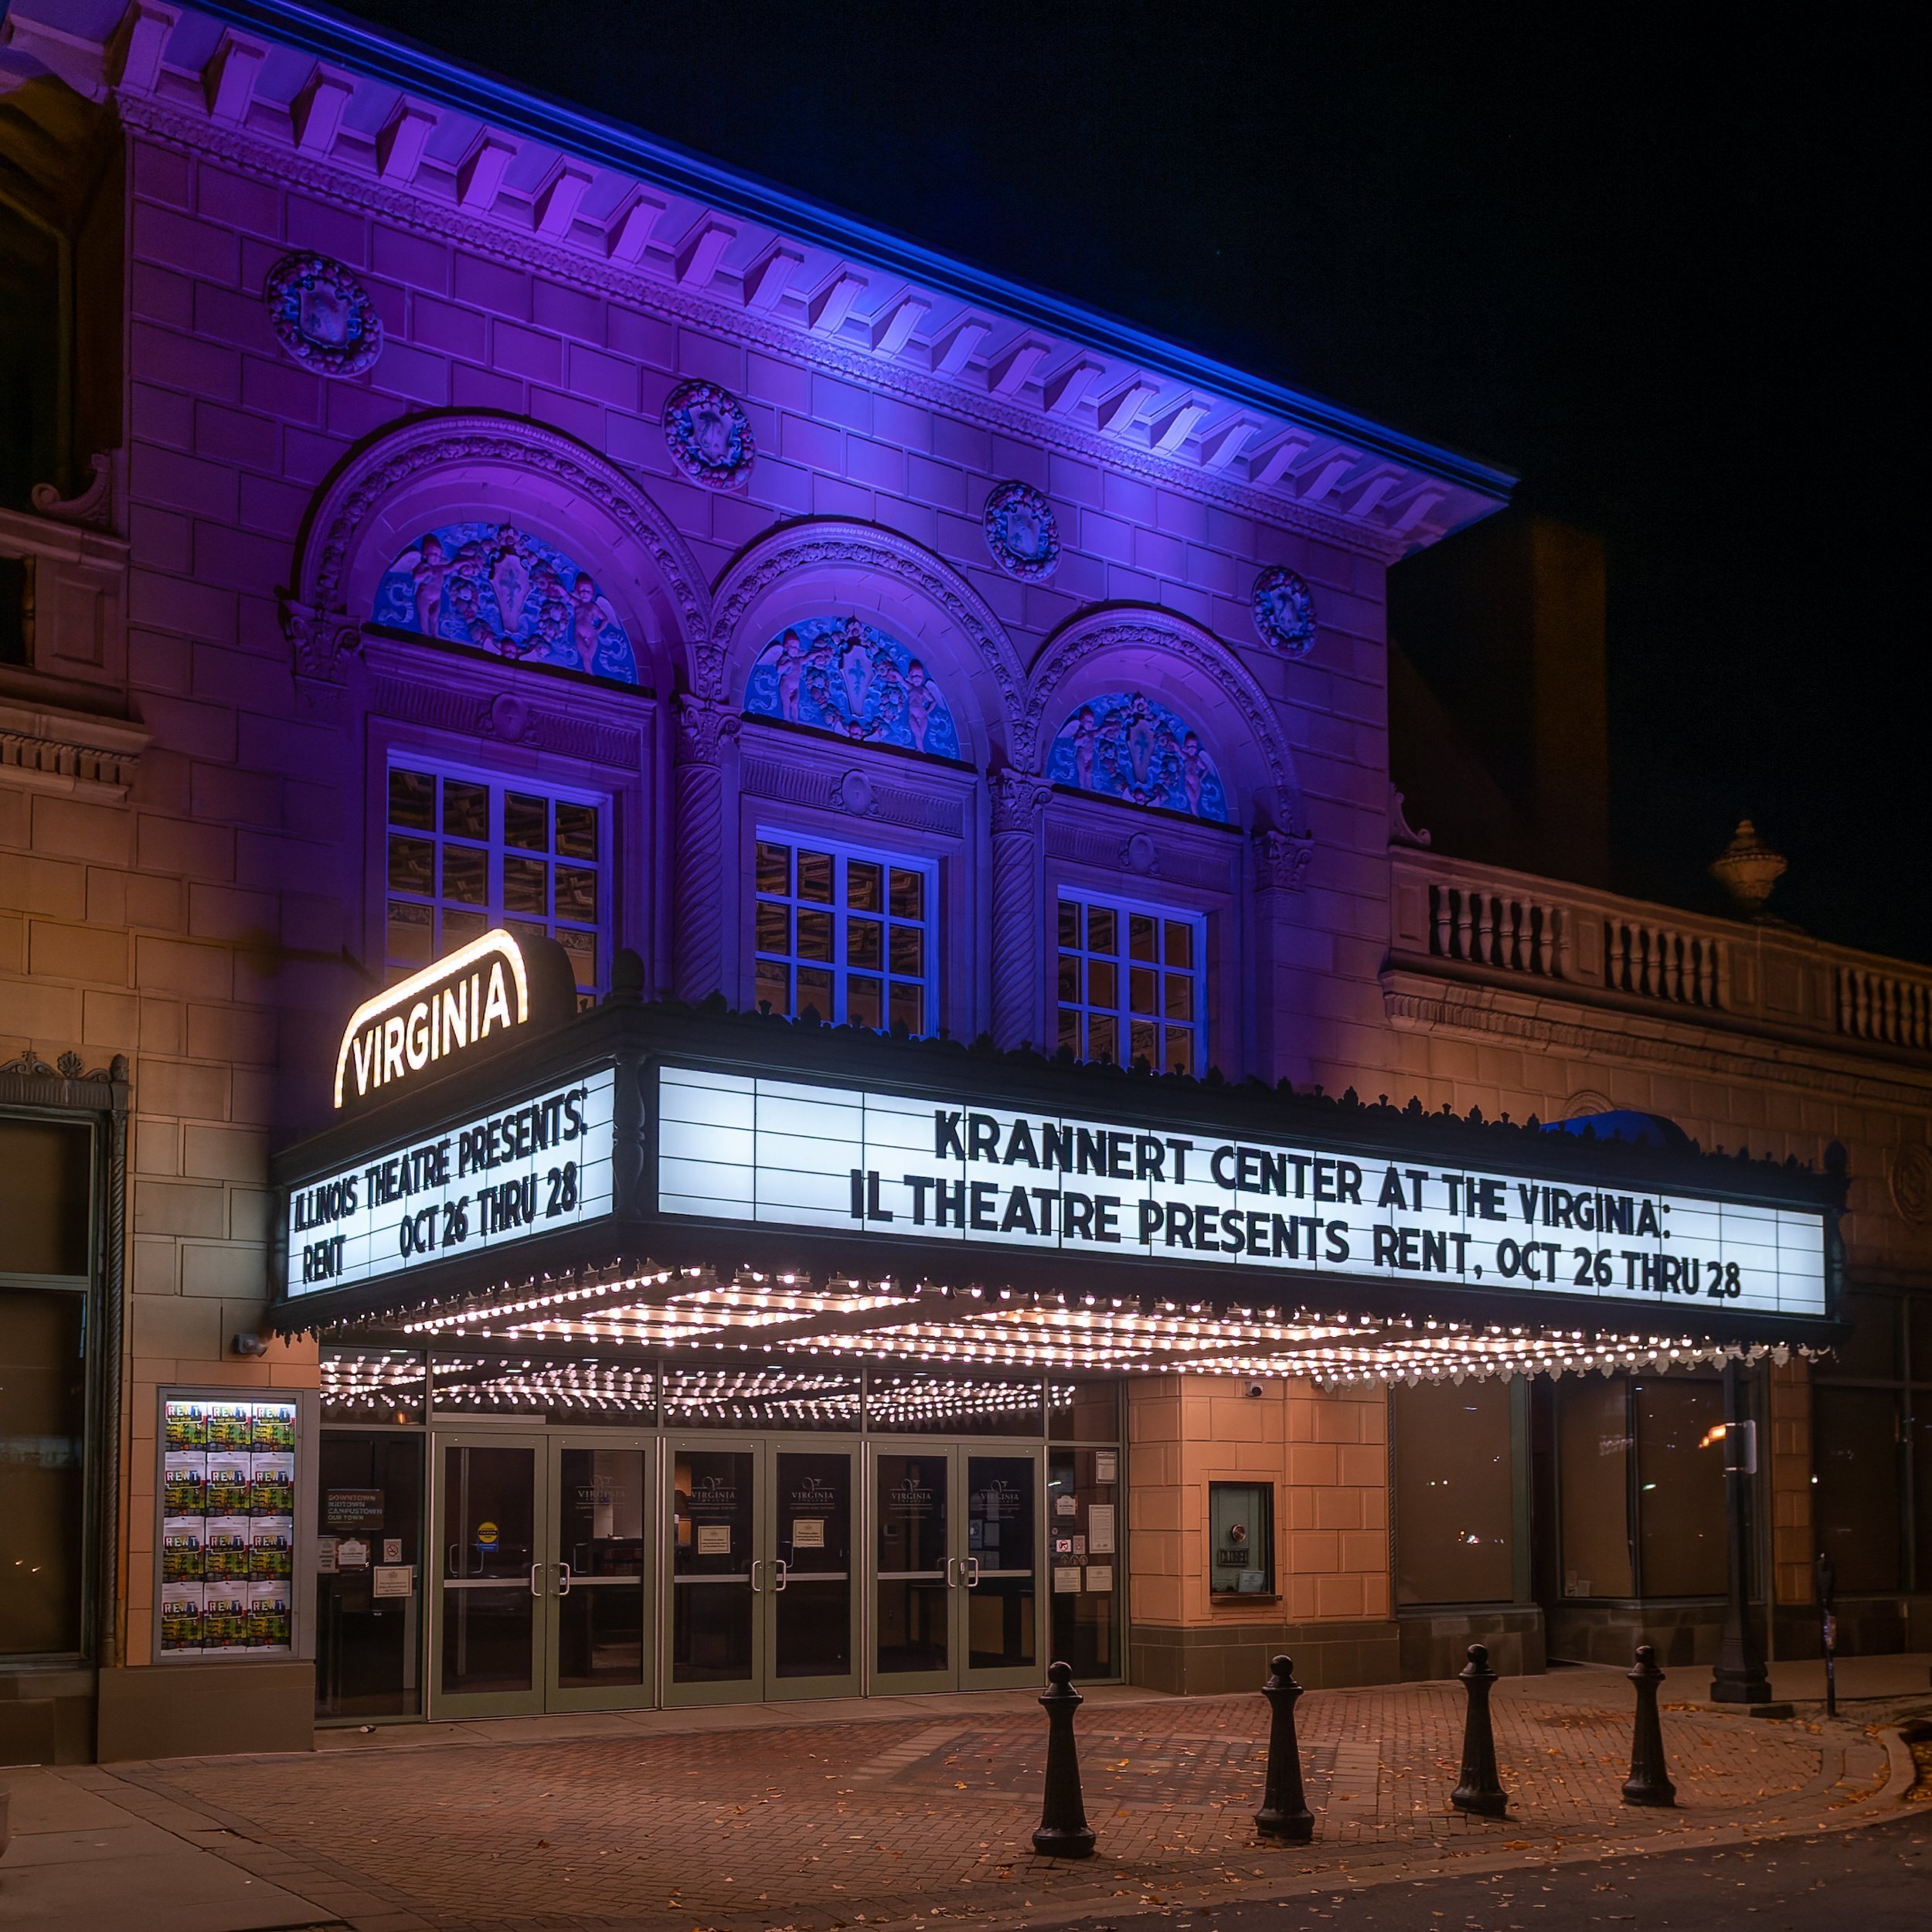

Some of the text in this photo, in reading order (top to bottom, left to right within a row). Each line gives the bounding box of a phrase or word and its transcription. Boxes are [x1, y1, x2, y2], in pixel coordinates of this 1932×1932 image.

[353, 961, 510, 1096] VIRGINIA
[294, 1087, 589, 1233] ILLINOIS THEATRE PRESENTS:
[934, 1110, 1671, 1240] KRANNERT CENTER AT THE VIRGINIA:
[303, 1161, 579, 1284] RENT OCT 26 THRU 28
[850, 1168, 1740, 1300] IL THEATRE PRESENTS RENT, OCT 26 THRU 28
[168, 1406, 199, 1416] RENT
[213, 1407, 244, 1417] RENT
[258, 1408, 287, 1418] RENT
[166, 1471, 199, 1481] RENT
[212, 1471, 243, 1481] RENT
[257, 1471, 287, 1481] RENT
[165, 1536, 197, 1547] RENT
[211, 1536, 242, 1546] RENT
[255, 1536, 284, 1546] RENT
[164, 1603, 196, 1613] RENT
[209, 1601, 240, 1611] RENT
[253, 1600, 282, 1611] RENT
